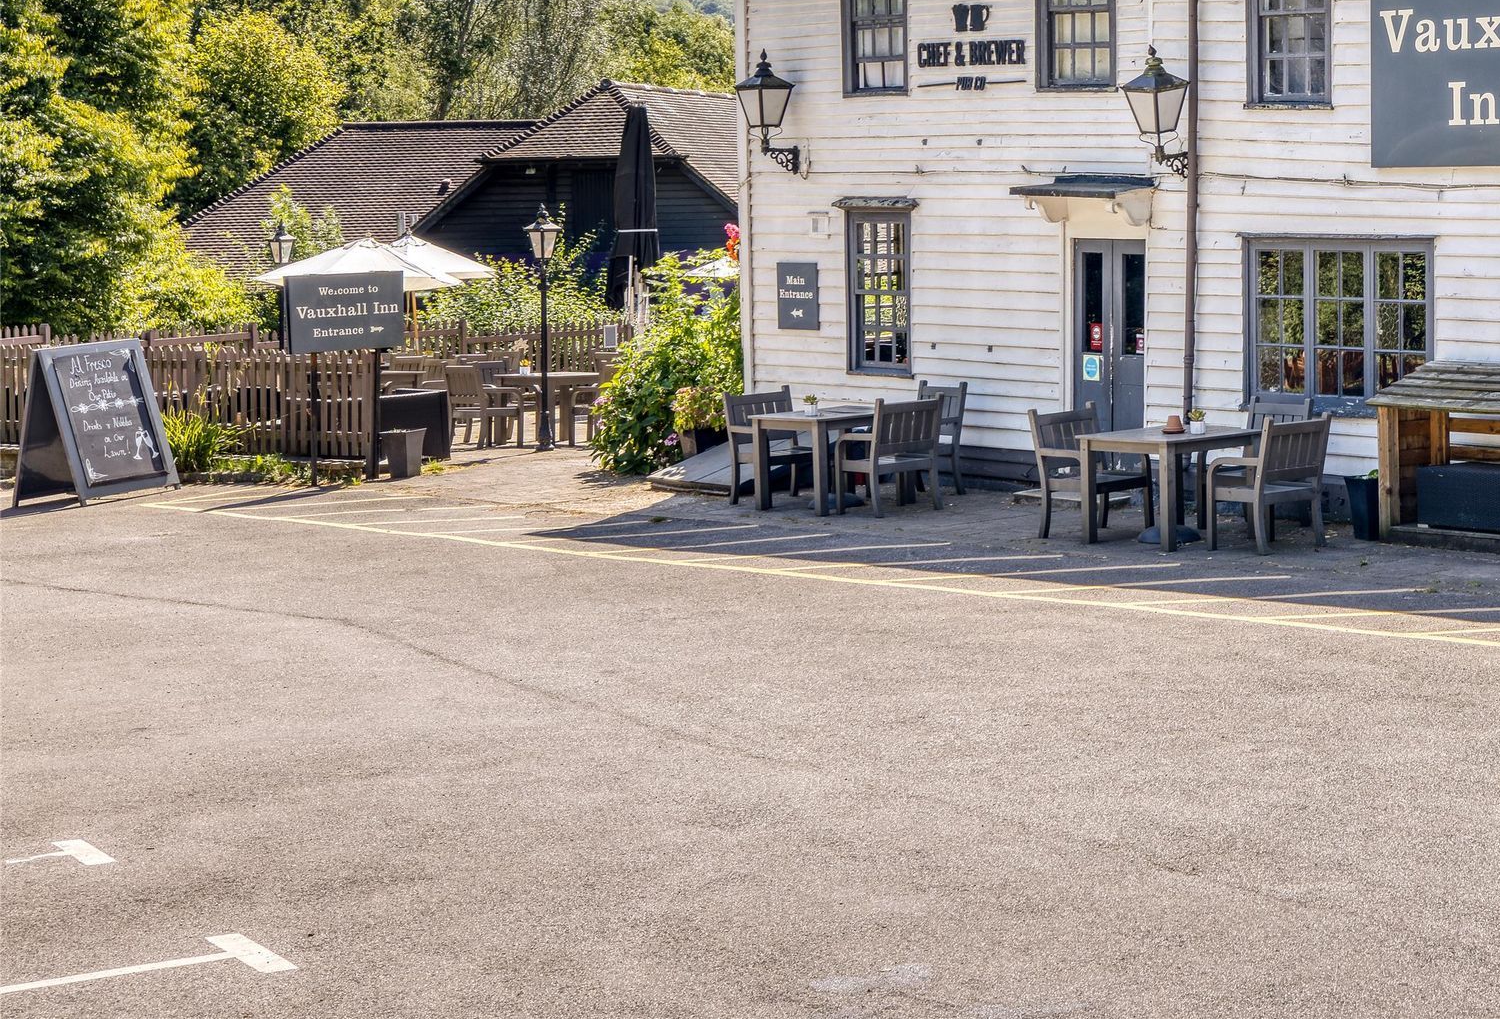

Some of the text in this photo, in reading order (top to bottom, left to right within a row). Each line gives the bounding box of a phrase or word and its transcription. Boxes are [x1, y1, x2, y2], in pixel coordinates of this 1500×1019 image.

[917, 39, 1026, 68] CHEF & BREWER
[955, 76, 987, 91] PUB CO
[785, 275, 806, 285] Main
[368, 284, 379, 293] to
[779, 288, 814, 299] Entrance
[296, 301, 400, 319] Vauxhall Inn
[312, 326, 364, 338] Entrance
[70, 354, 112, 375] Al Fresco
[70, 376, 93, 392] Dining
